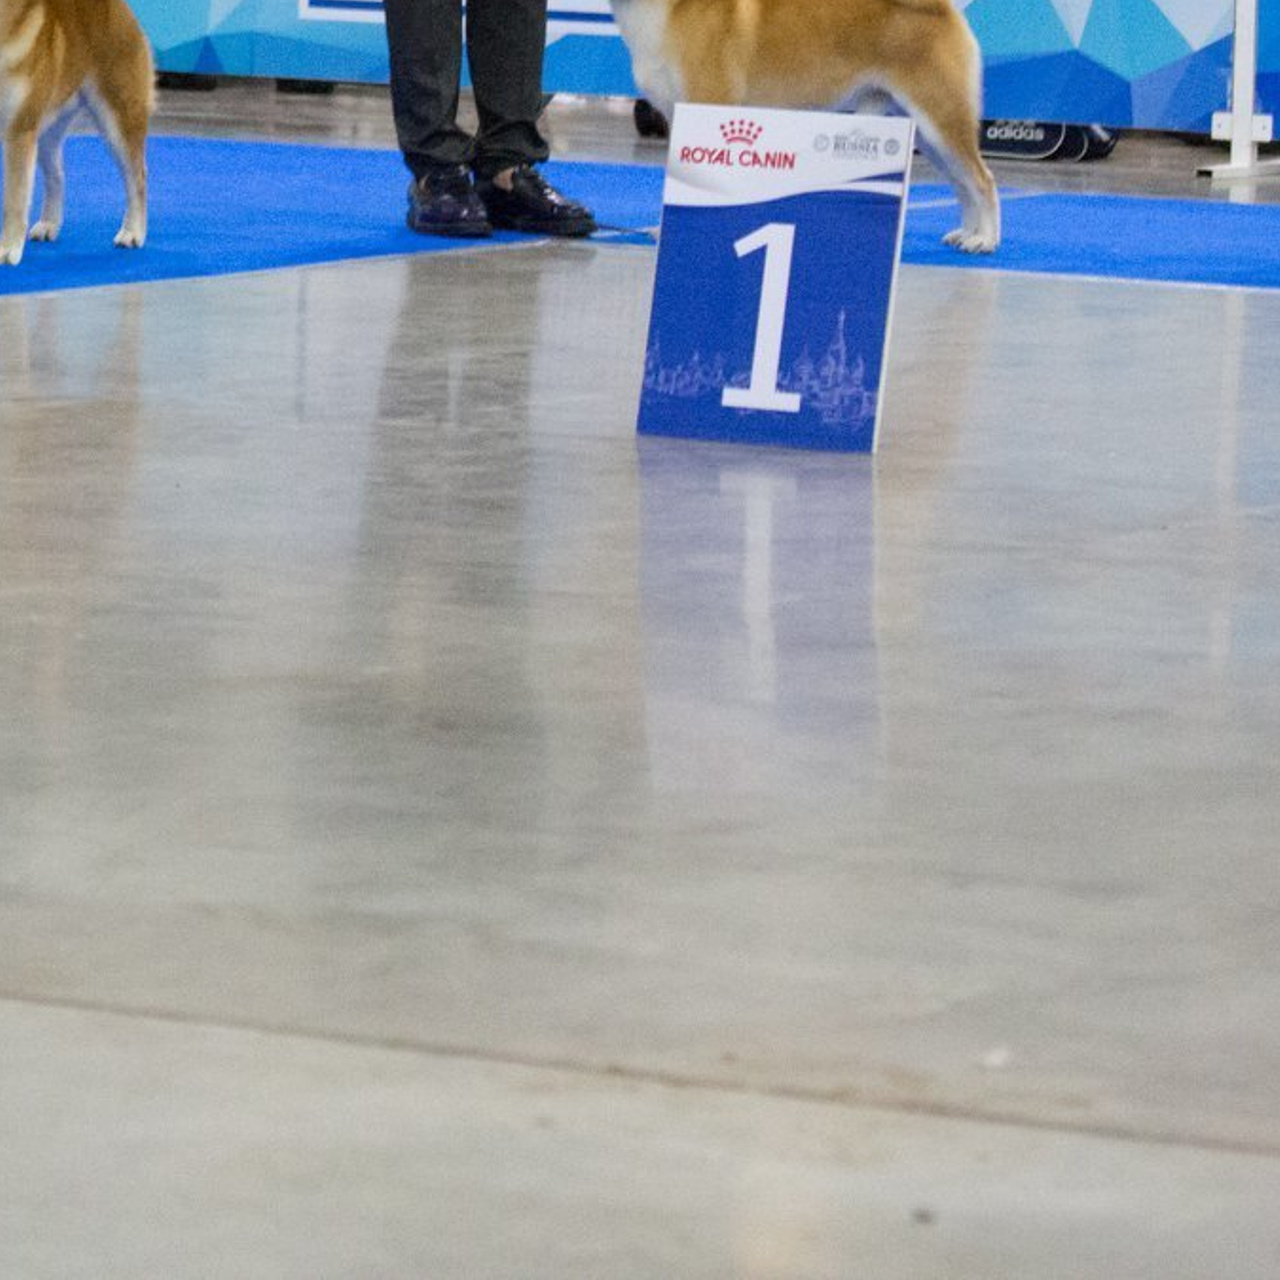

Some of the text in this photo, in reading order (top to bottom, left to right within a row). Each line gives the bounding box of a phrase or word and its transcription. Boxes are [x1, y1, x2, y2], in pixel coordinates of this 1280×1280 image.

[987, 126, 1045, 140] adidas
[680, 146, 796, 169] ROYAL CANIN
[721, 223, 801, 412] 1
